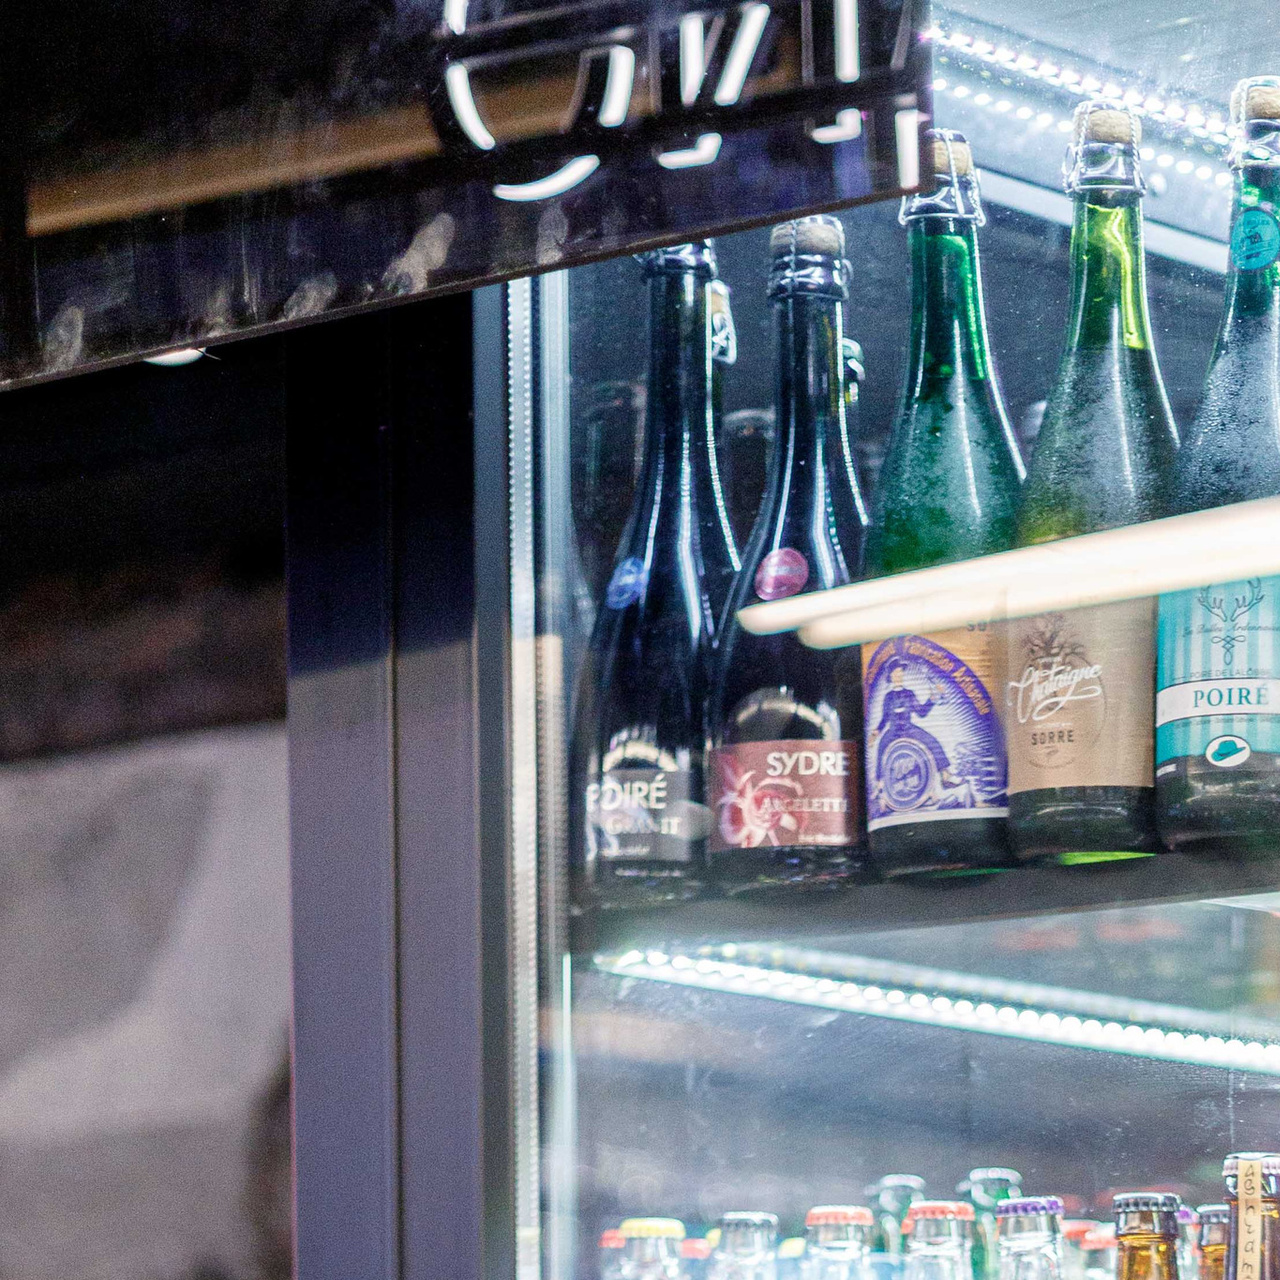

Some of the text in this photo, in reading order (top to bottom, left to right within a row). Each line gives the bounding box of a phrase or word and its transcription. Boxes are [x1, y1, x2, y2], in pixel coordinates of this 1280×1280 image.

[1192, 686, 1269, 708] POIRÉ
[1030, 729, 1075, 745] SORRE
[766, 751, 850, 777] SYDRE
[586, 772, 668, 813] POIRÉ
